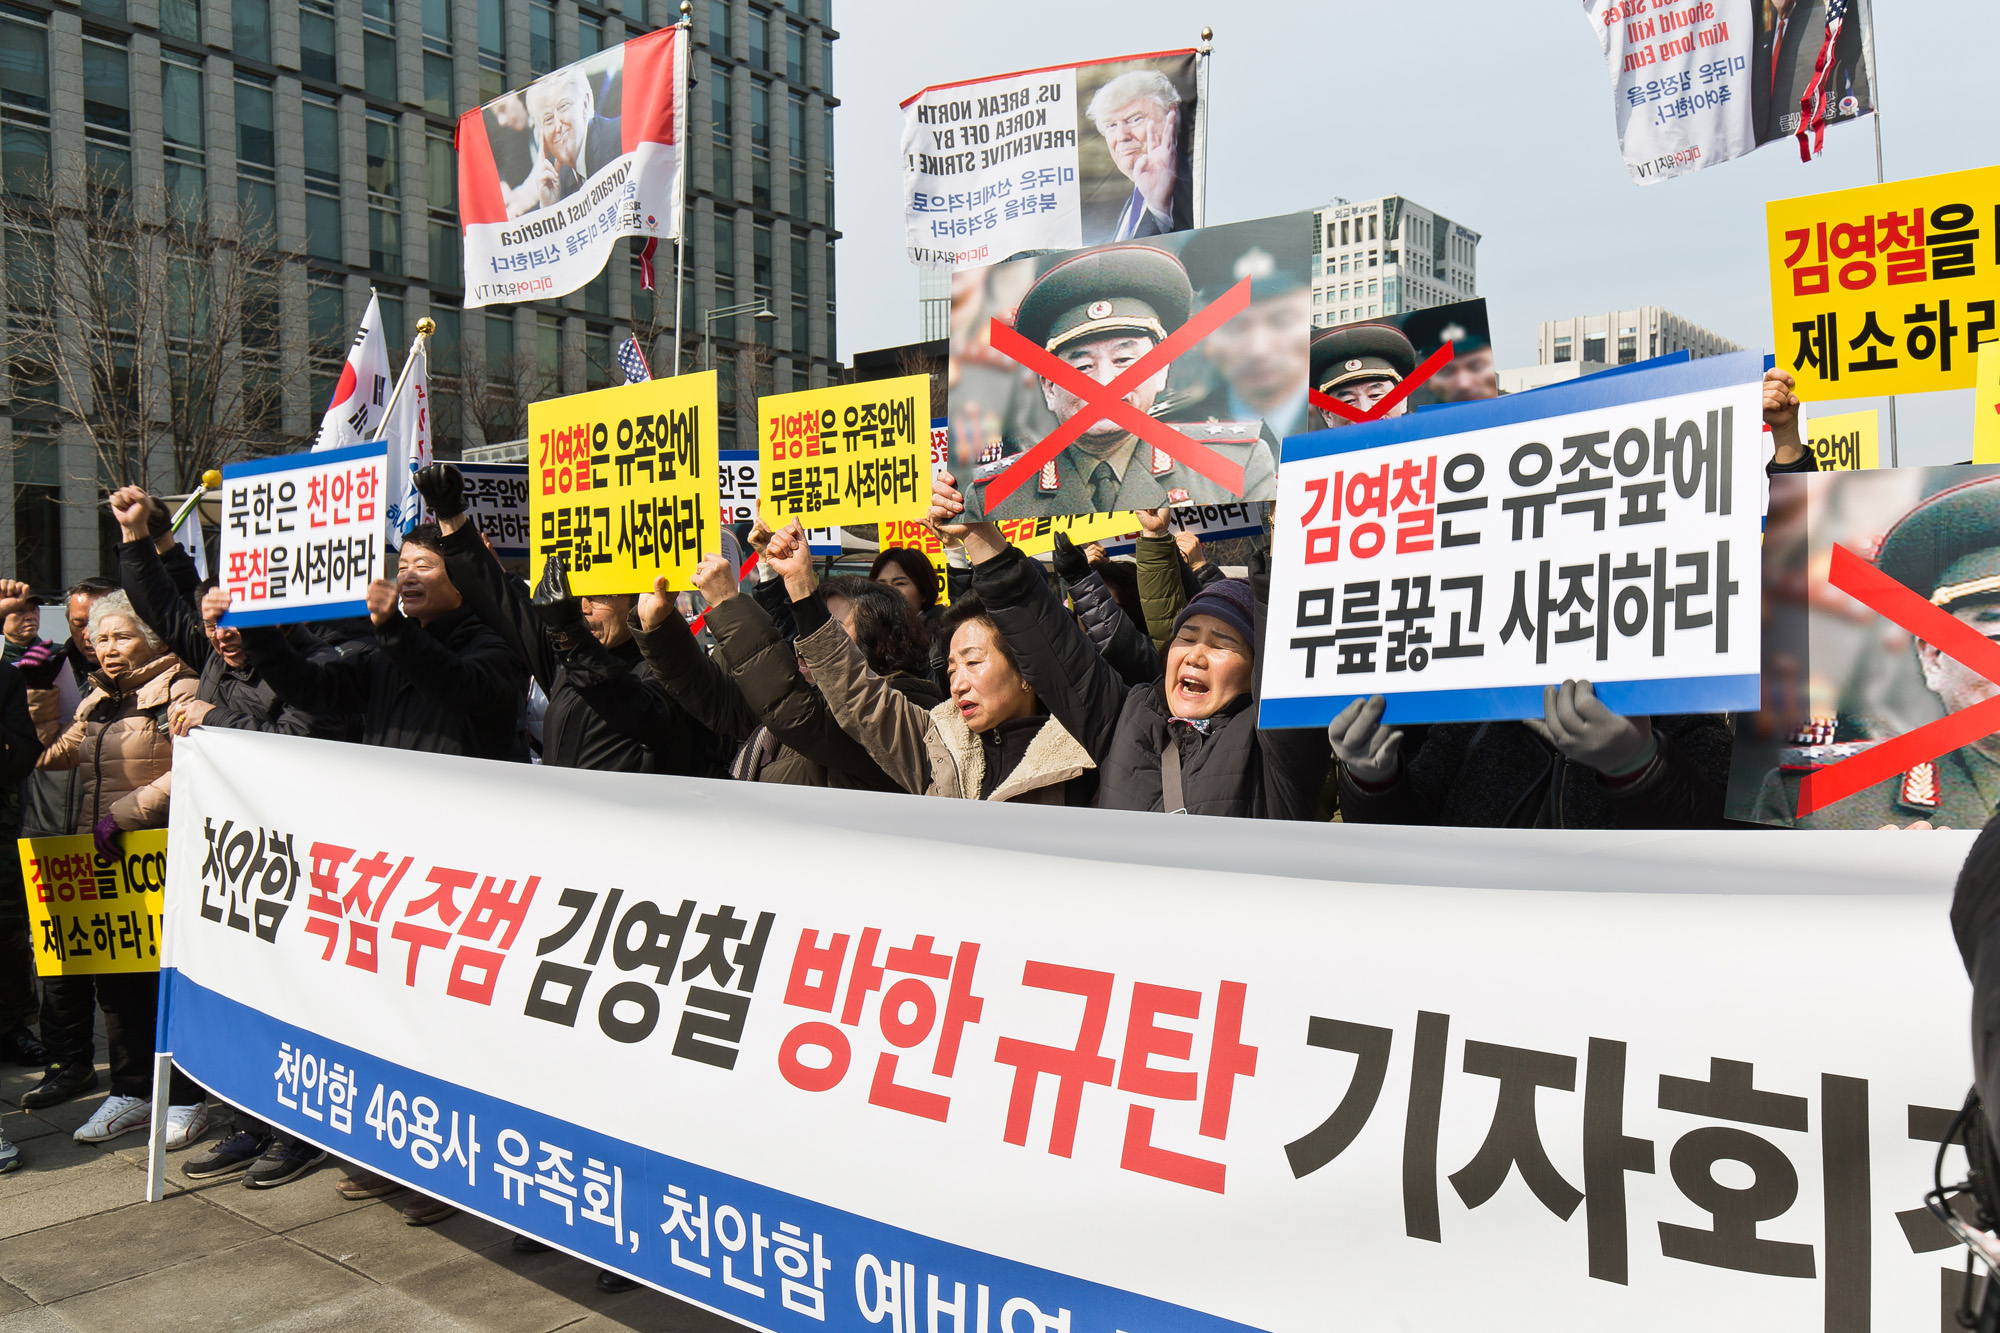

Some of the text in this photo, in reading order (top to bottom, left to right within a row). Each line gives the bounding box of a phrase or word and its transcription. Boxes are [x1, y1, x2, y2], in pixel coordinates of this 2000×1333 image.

[1784, 203, 1980, 297] 김영철을
[540, 405, 700, 496] 김영철은 유족앞에
[770, 408, 838, 461] 김영철은
[843, 396, 915, 452] 유족앞에
[229, 481, 297, 538] 북한은
[307, 466, 379, 528] 천안함
[771, 454, 918, 516] 무릎꿇고 사죄하라
[1301, 406, 1734, 565] 김영철은 유족앞에
[227, 534, 375, 602] 폭침을 사죄하라
[540, 493, 704, 572] 무릎꿇고 사죄하라
[1290, 540, 1738, 678] 무릎꿇고 사죄하라
[30, 853, 118, 903] 김영철을
[200, 817, 301, 944] 천안함
[524, 888, 776, 1071] 김영철
[778, 927, 984, 1123] 방한
[994, 960, 1258, 1195] 규탄
[274, 1041, 358, 1135] 천안함
[365, 1083, 481, 1187] 46용사
[493, 1128, 640, 1254] 유족회,
[660, 1184, 831, 1321] 천안함
